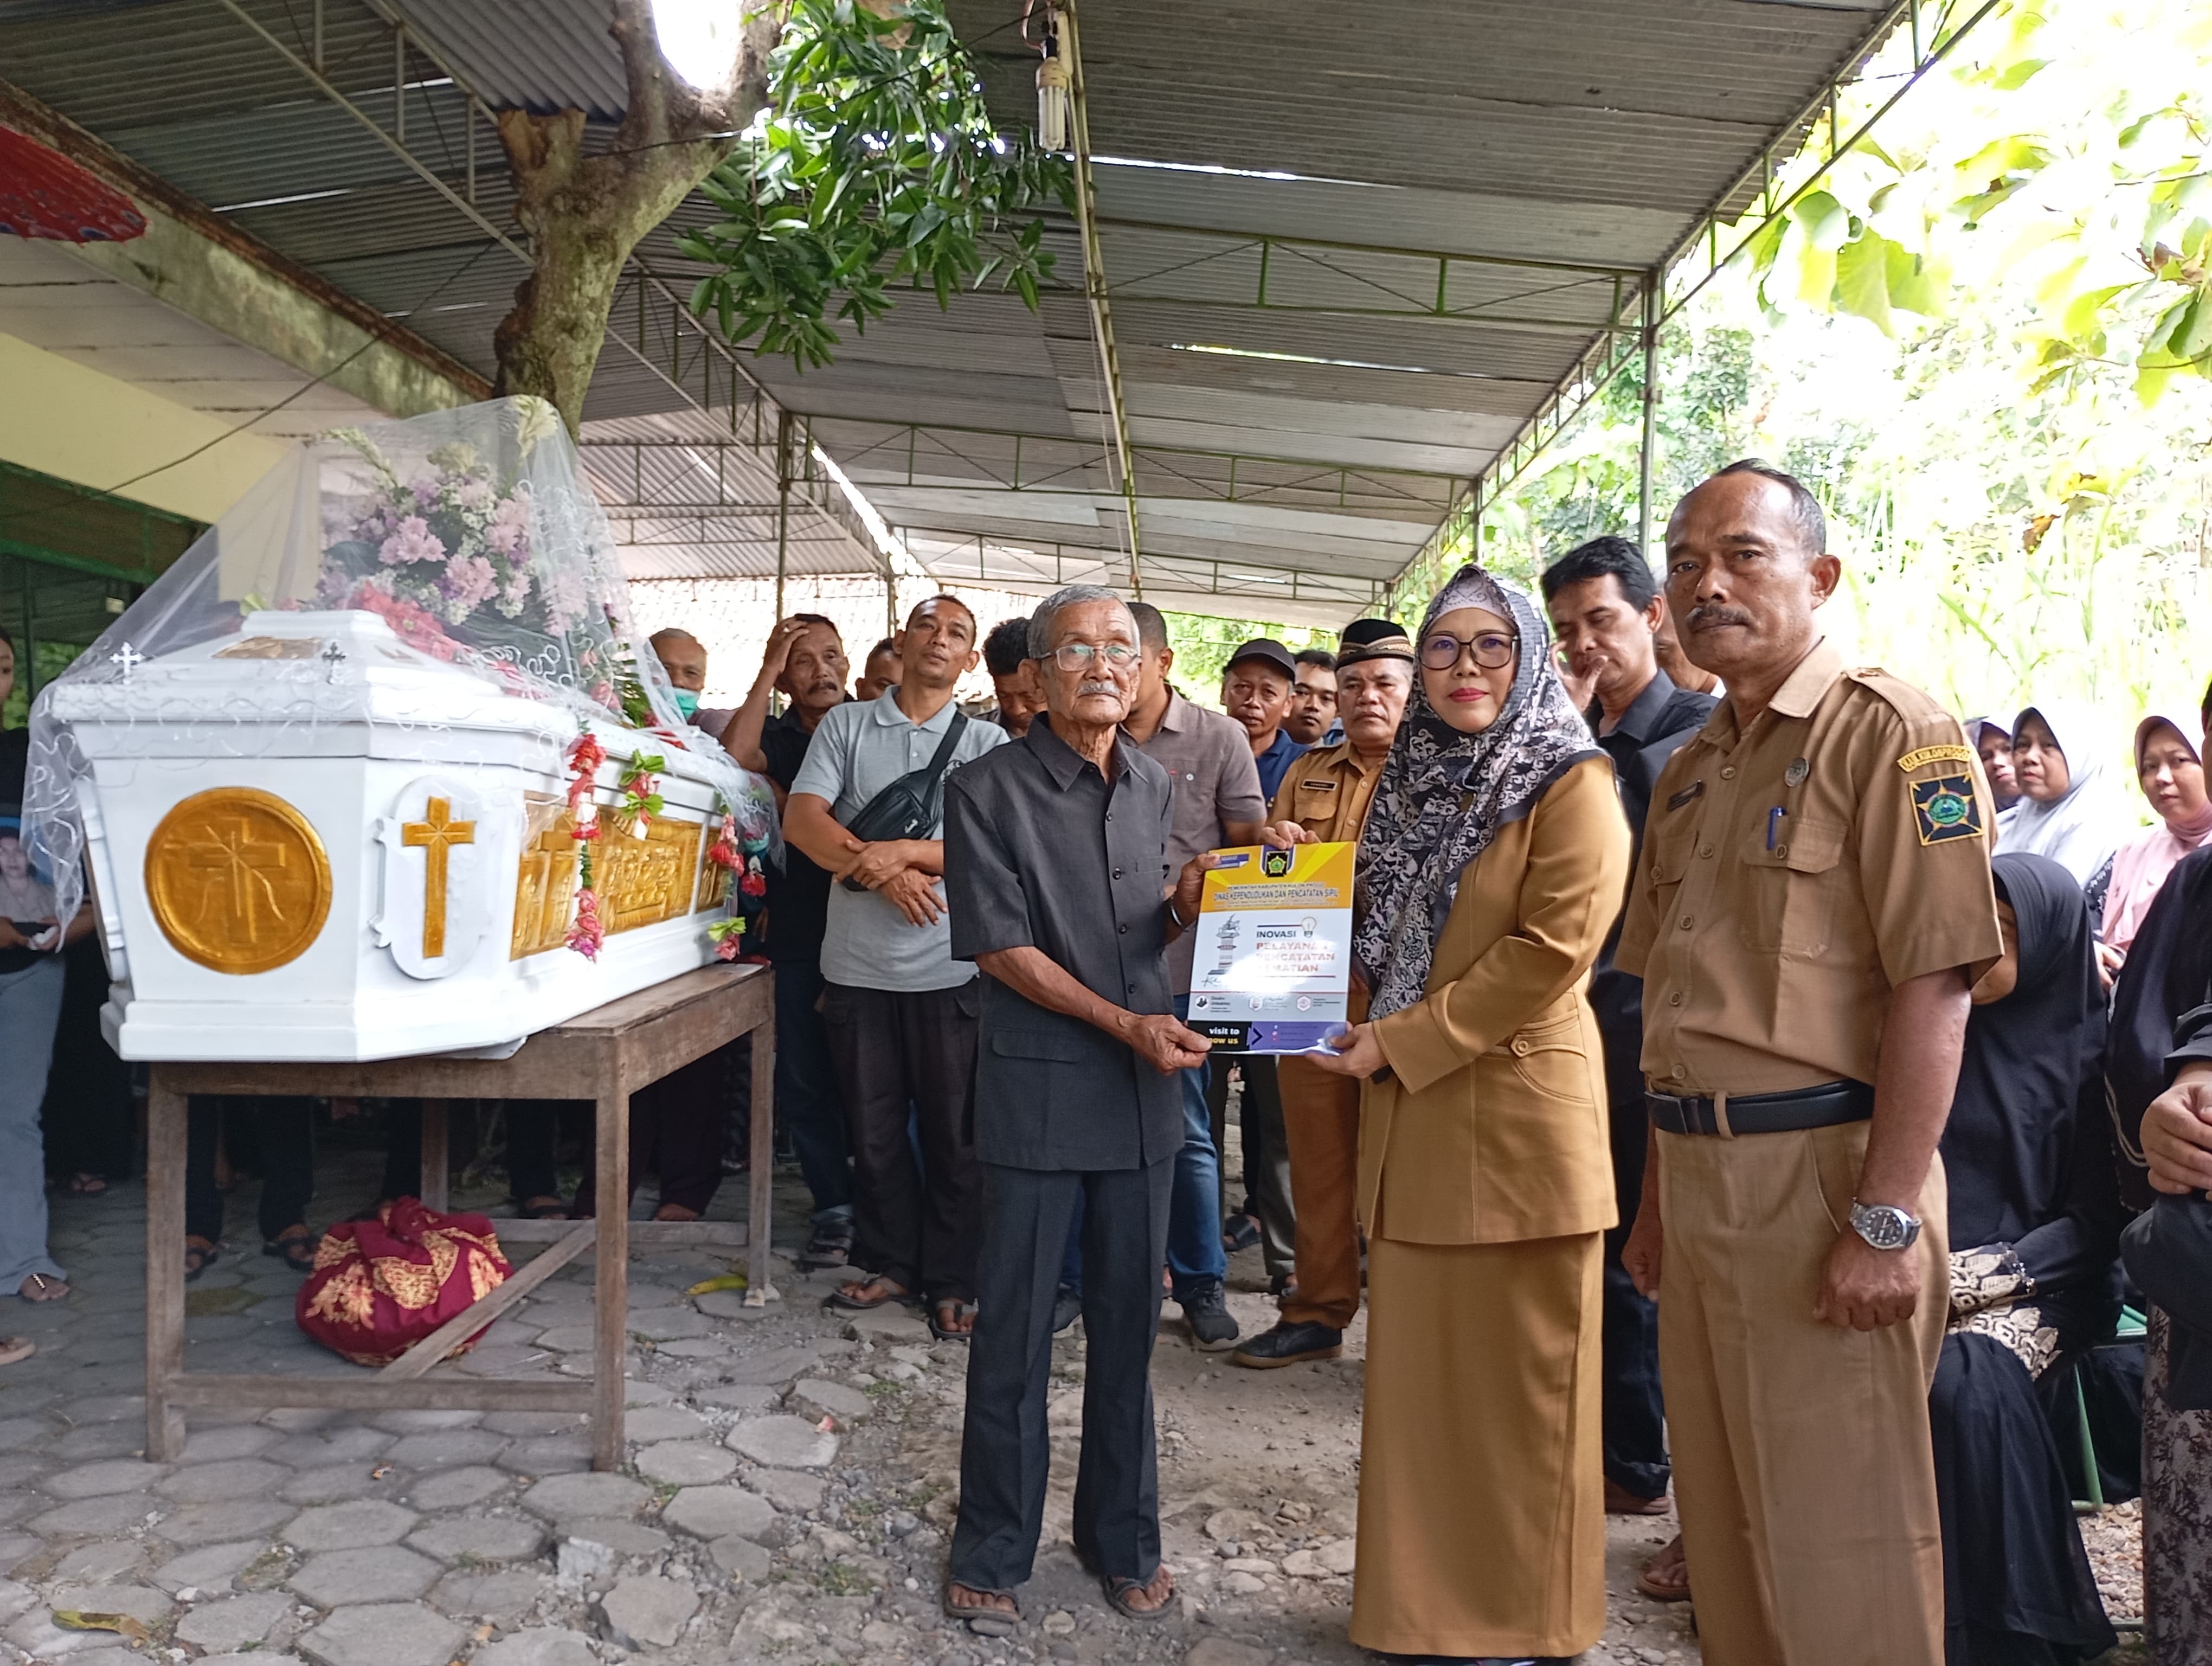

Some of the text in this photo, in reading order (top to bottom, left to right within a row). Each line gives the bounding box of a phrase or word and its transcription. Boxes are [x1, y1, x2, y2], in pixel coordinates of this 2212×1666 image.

[1213, 888, 1339, 901] DINAS KEPENDUDUKAN DAN PENCATATAN SIPIL
